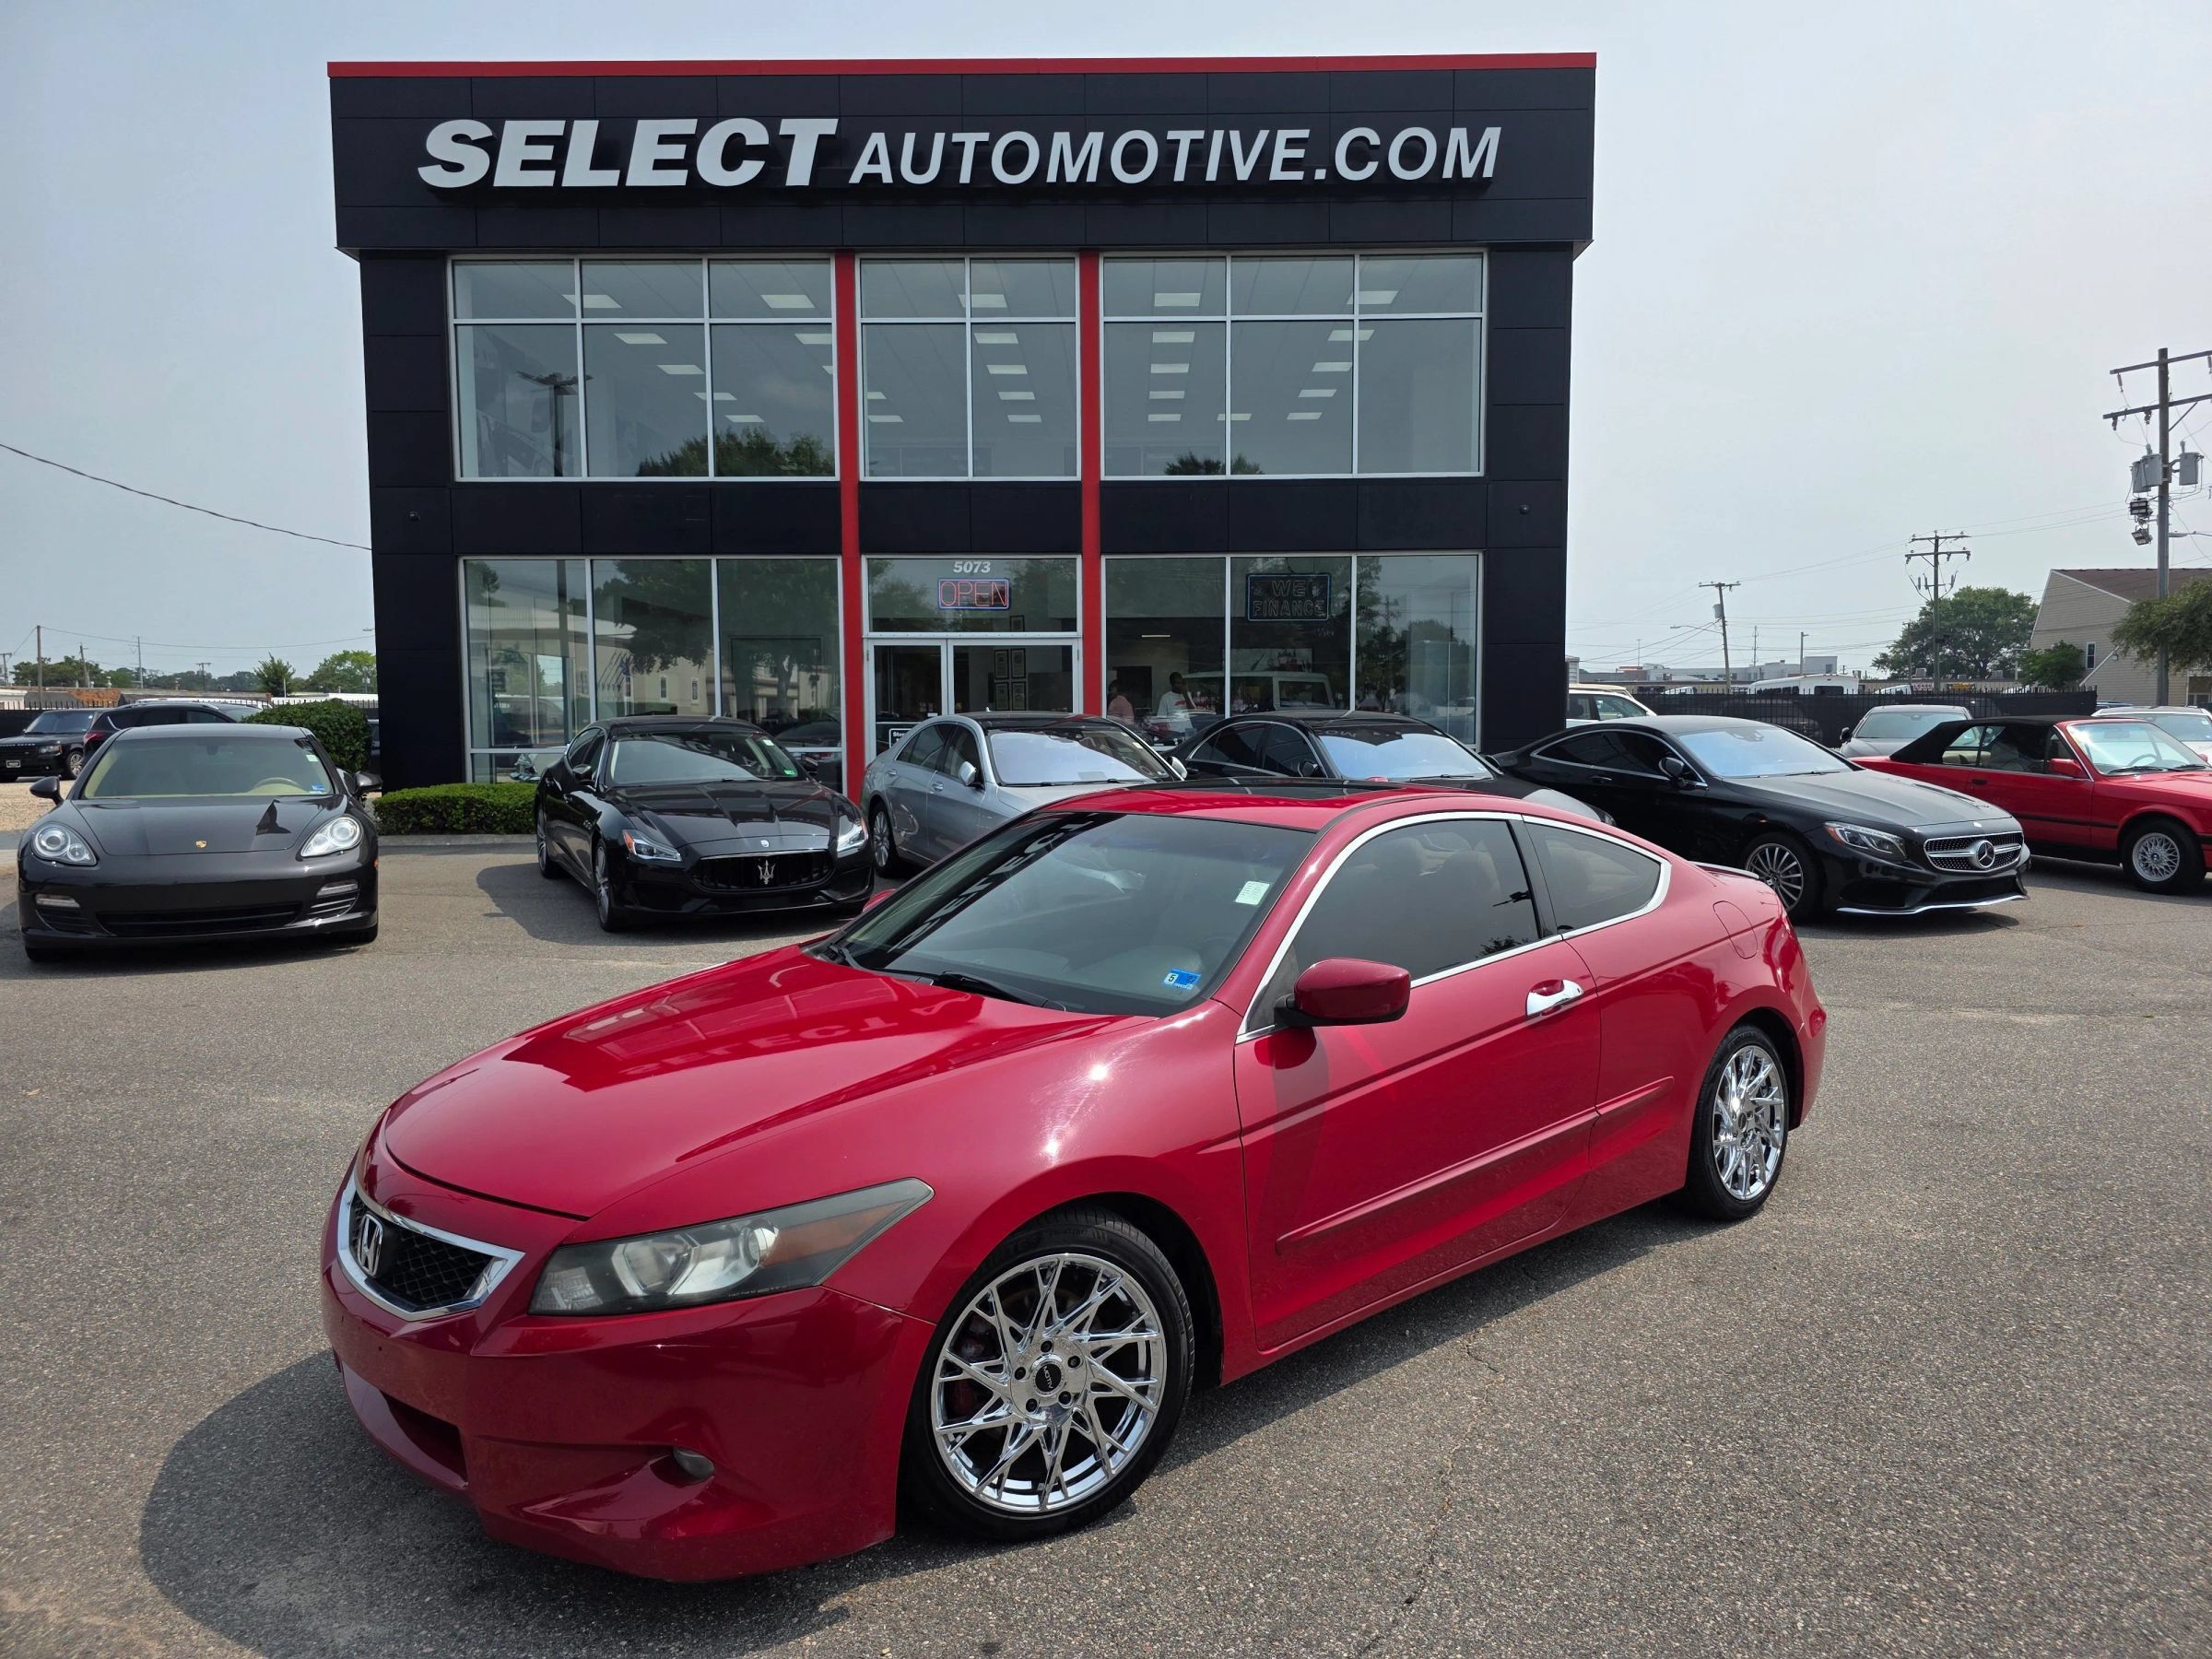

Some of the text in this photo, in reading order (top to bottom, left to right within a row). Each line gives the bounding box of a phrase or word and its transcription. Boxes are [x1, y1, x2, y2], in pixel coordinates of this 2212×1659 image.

[418, 118, 1502, 188] SELECT AUTOMOTIVE.COM
[953, 560, 991, 573] 5073
[940, 581, 1007, 606] OPEN
[1271, 579, 1307, 597] WE
[1253, 599, 1325, 617] FINANCE
